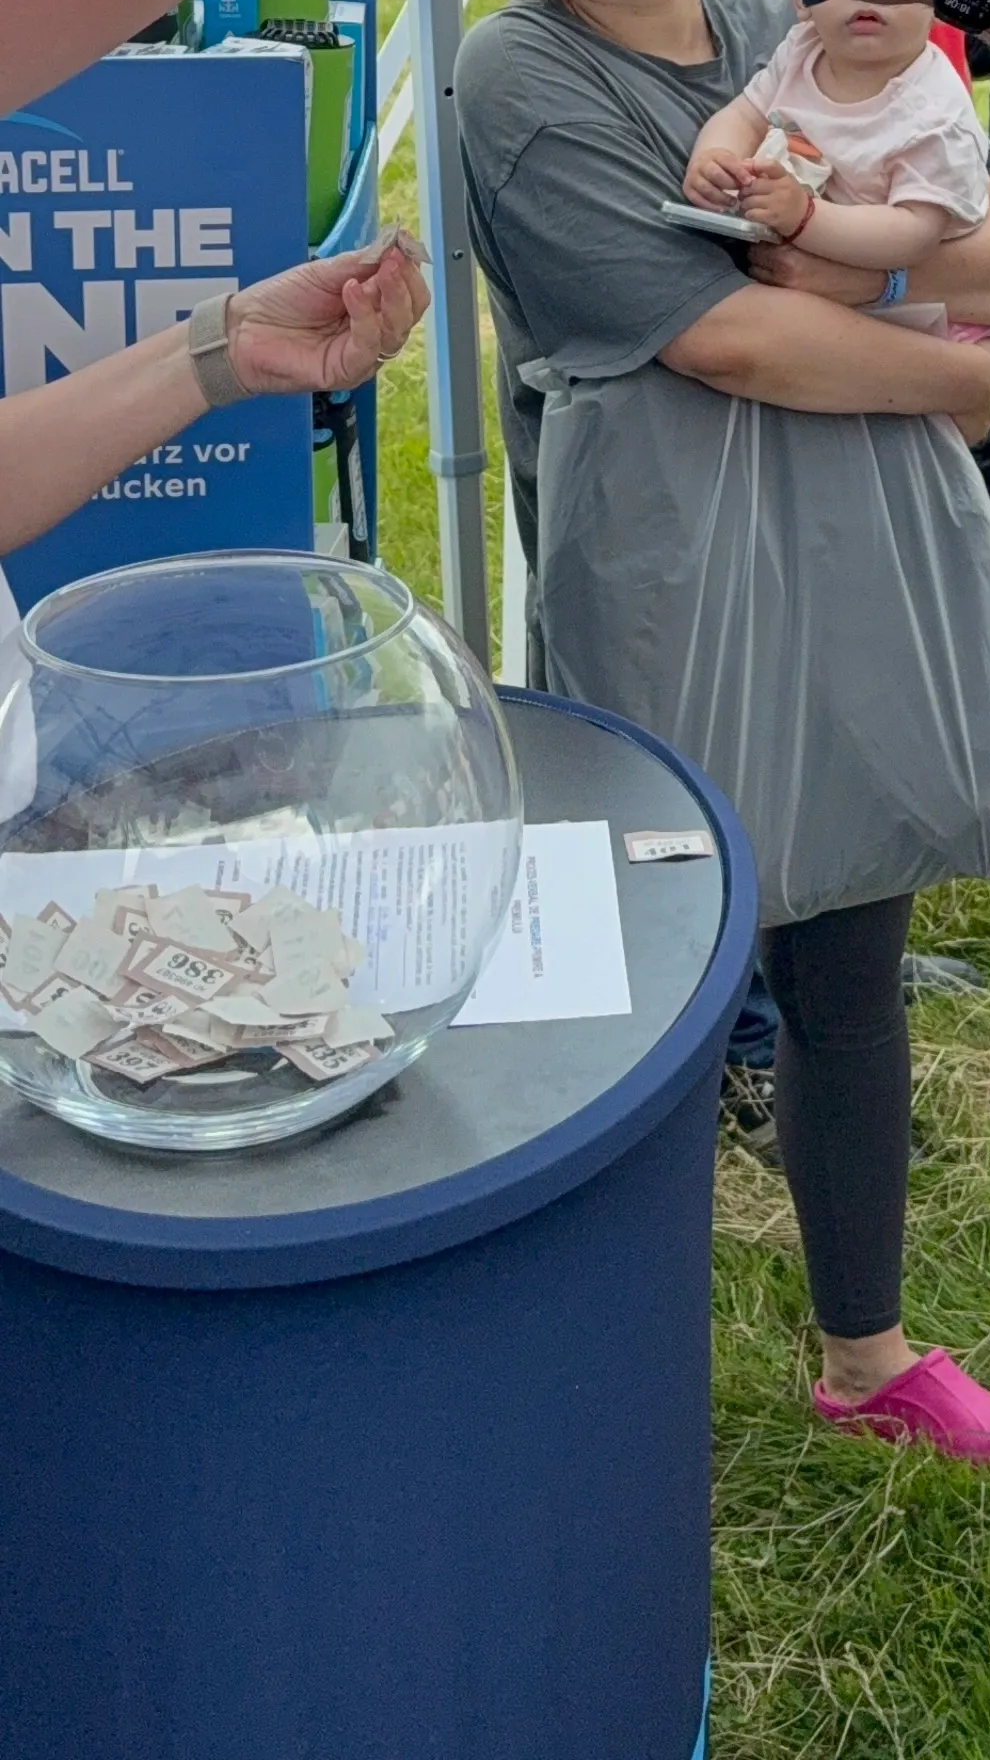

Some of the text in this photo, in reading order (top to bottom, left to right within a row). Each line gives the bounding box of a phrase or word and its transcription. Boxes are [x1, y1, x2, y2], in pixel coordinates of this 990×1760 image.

[53, 207, 233, 270] THE
[194, 442, 250, 463] vor
[92, 472, 207, 501] ücken
[166, 952, 225, 986] 386
